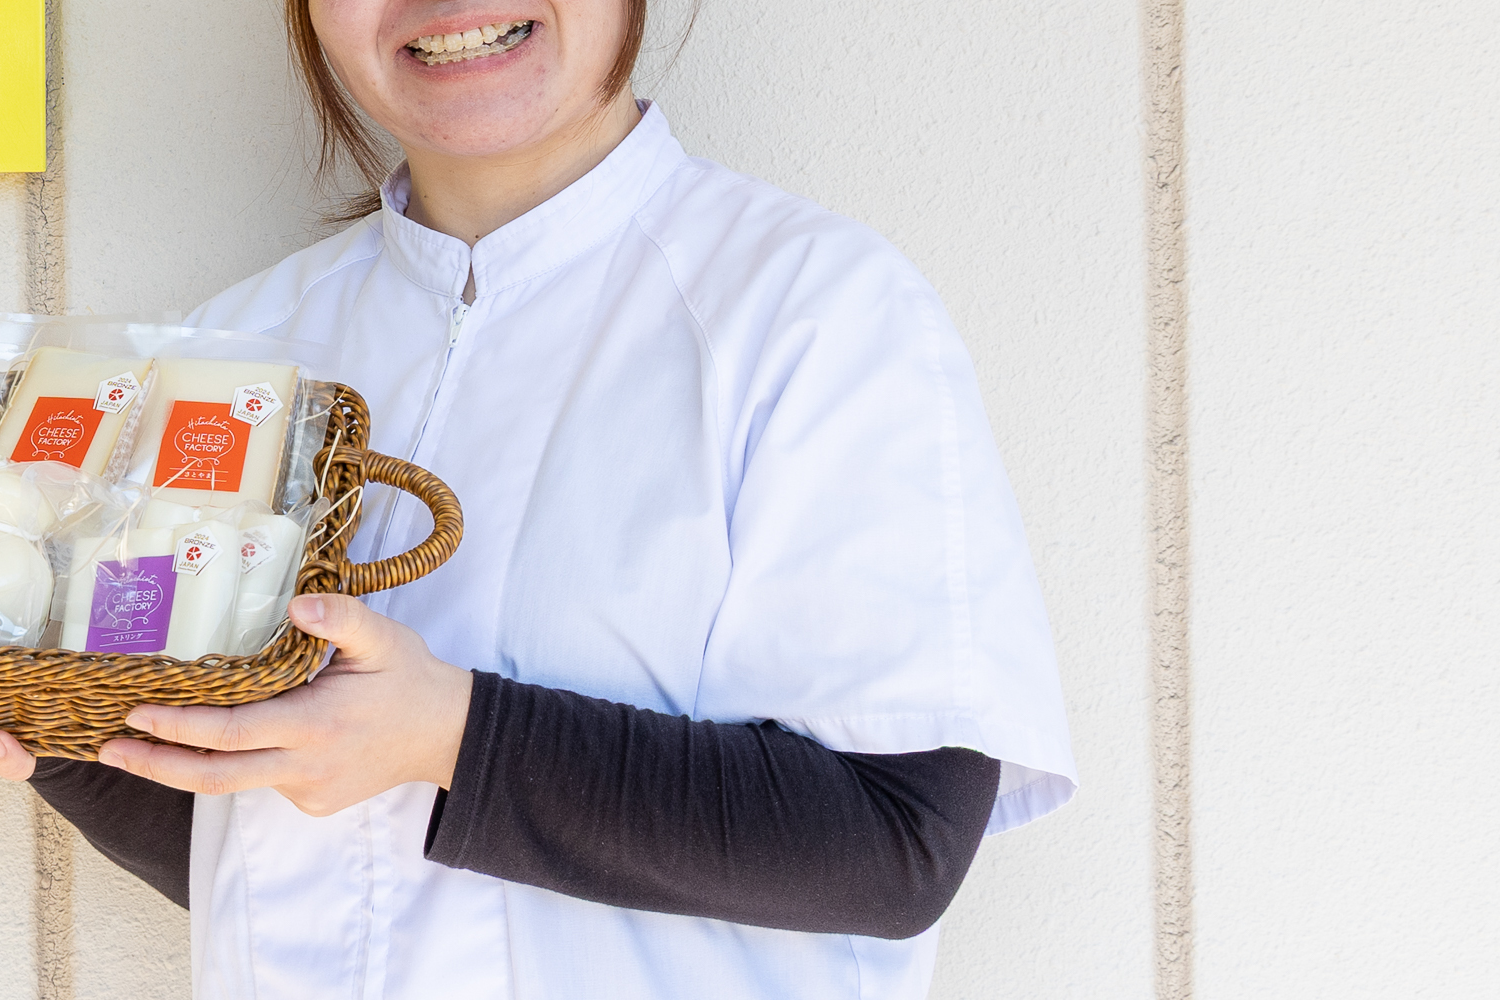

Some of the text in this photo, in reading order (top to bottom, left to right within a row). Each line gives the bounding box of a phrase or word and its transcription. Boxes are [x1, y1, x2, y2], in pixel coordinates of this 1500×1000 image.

[107, 380, 137, 391] BRONZE
[255, 386, 271, 396] 2024
[243, 388, 276, 404] BRONZE
[100, 400, 121, 408] JAPAN
[237, 409, 260, 421] JAPAN
[38, 426, 80, 439] CHEESE
[37, 438, 72, 446] FACTORY
[182, 432, 229, 445] CHEESE
[184, 443, 224, 453] FACTORY
[194, 533, 210, 541] 2024
[184, 538, 216, 550] BRONZE
[179, 561, 199, 569] JAPAN
[112, 590, 158, 604] CHEESE
[114, 602, 153, 613] FACTORY
[113, 632, 144, 642] ストリング
